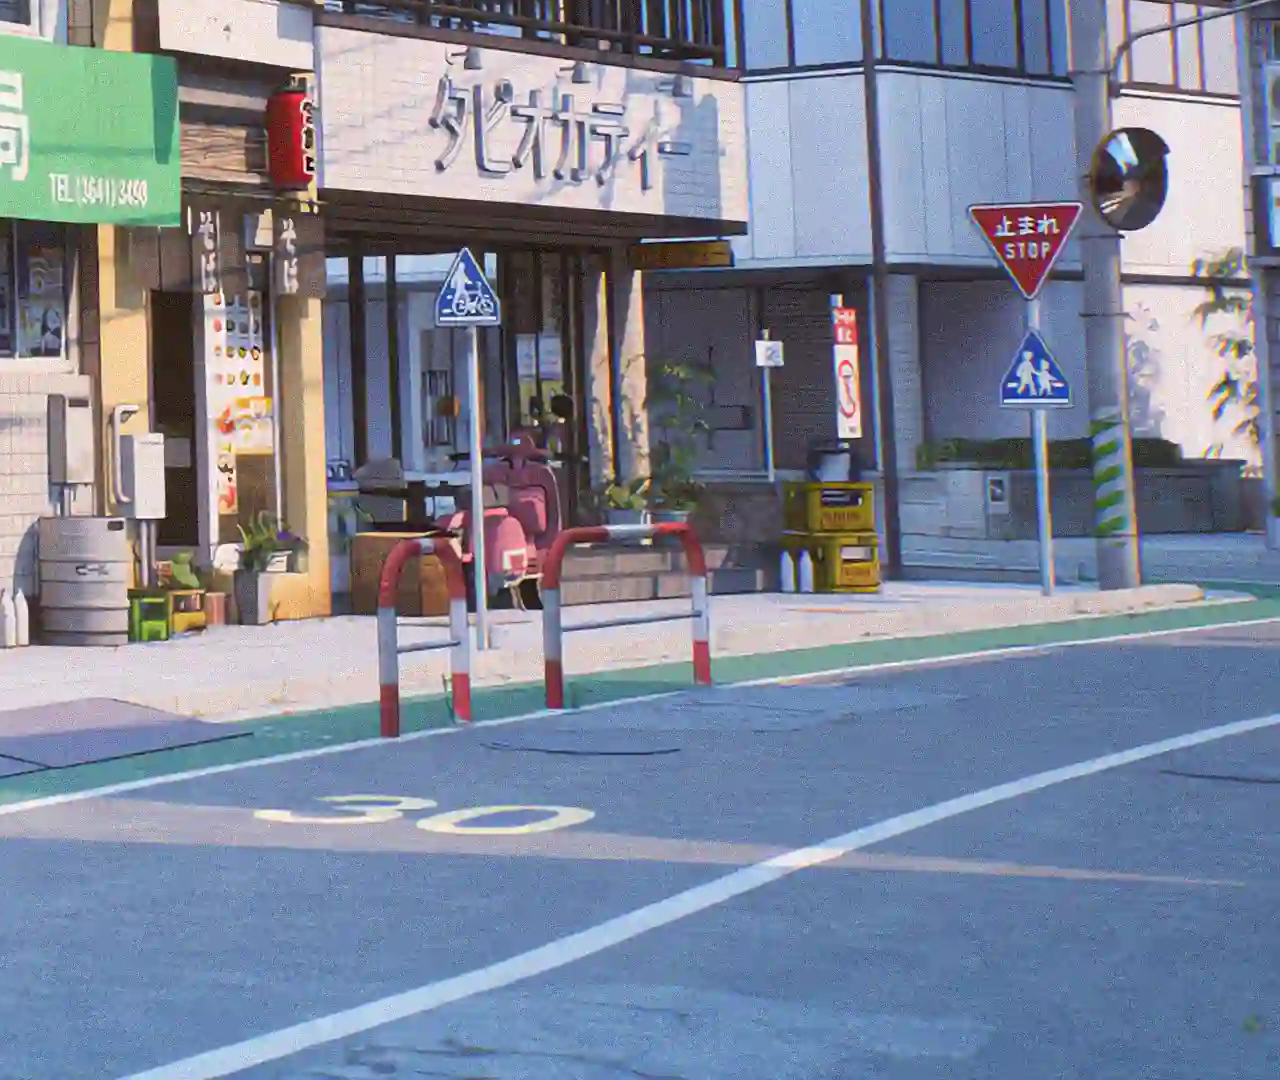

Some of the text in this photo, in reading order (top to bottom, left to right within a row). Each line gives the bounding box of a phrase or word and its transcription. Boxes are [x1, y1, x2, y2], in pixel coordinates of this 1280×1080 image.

[49, 172, 75, 203] TEL
[994, 214, 1060, 238] 止まれ
[1004, 240, 1051, 261] STOP
[253, 794, 596, 835] 30
